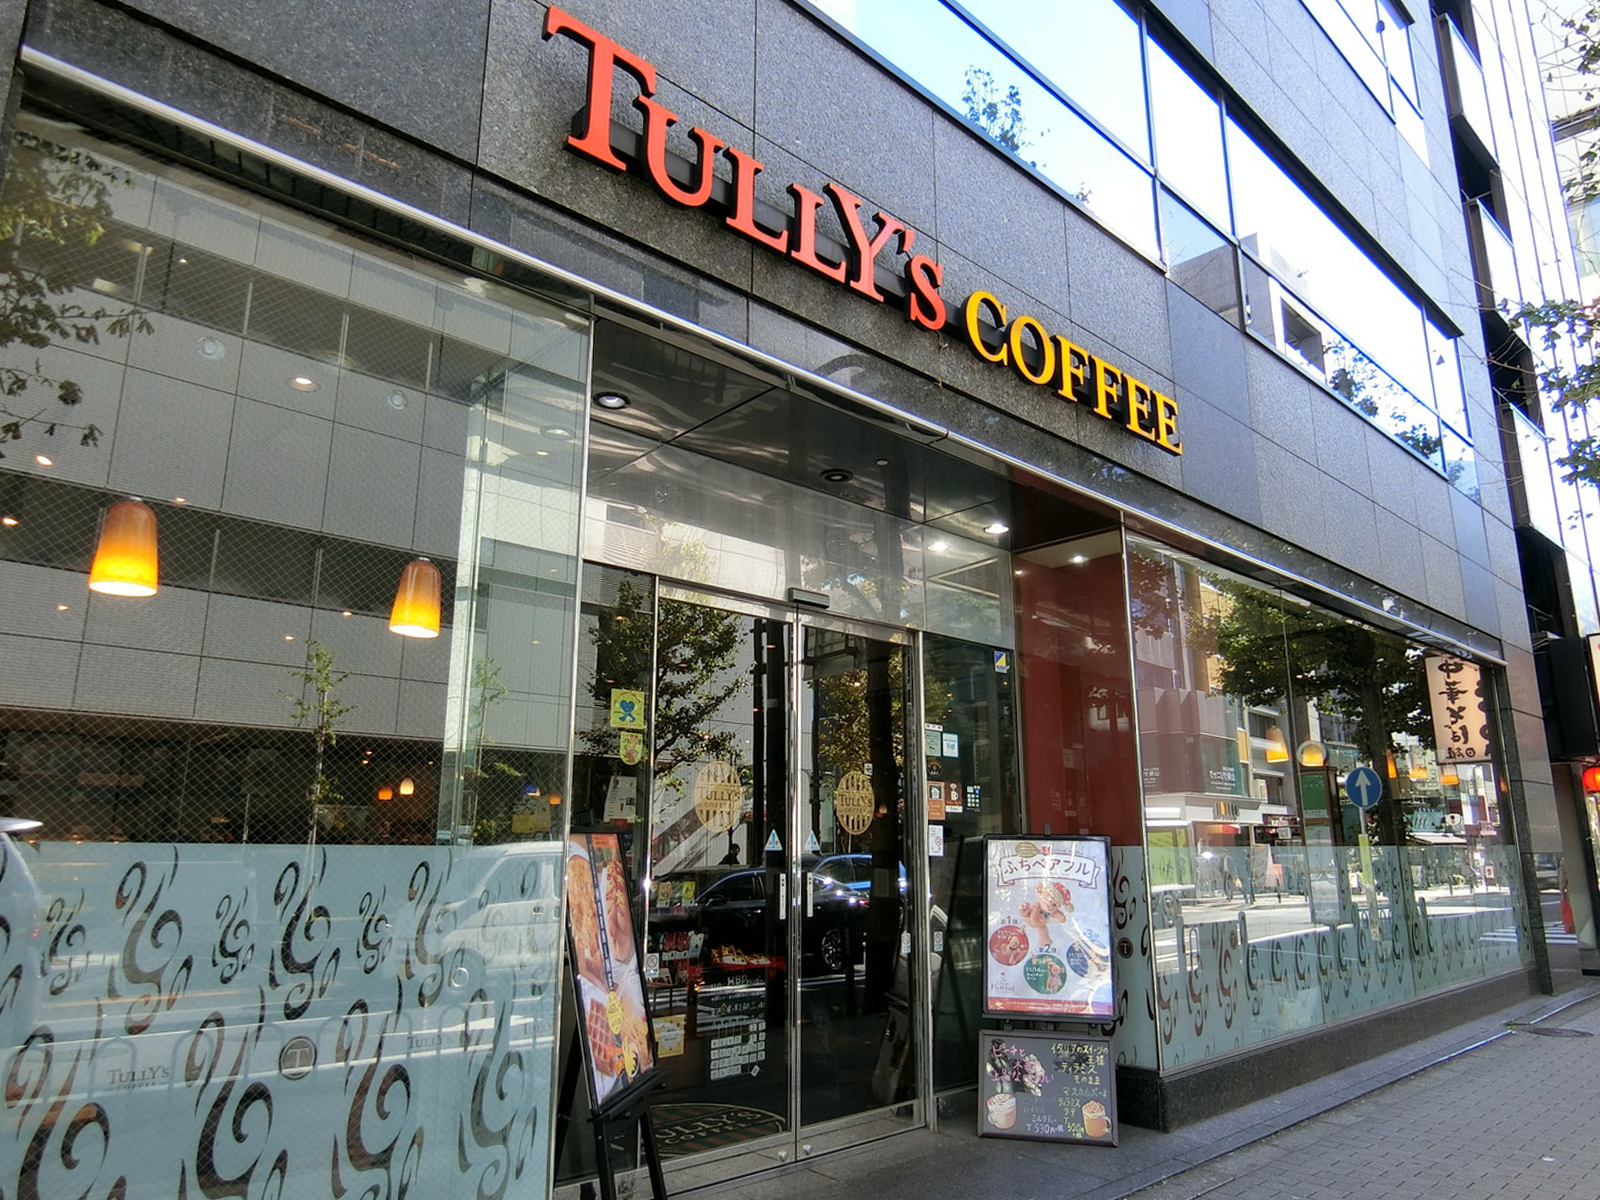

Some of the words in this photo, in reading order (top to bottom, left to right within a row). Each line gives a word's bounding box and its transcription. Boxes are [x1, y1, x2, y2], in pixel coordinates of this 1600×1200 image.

[542, 5, 947, 331] TULLY'S
[963, 290, 1183, 456] COFFEE
[107, 1065, 170, 1085] TULLY'S
